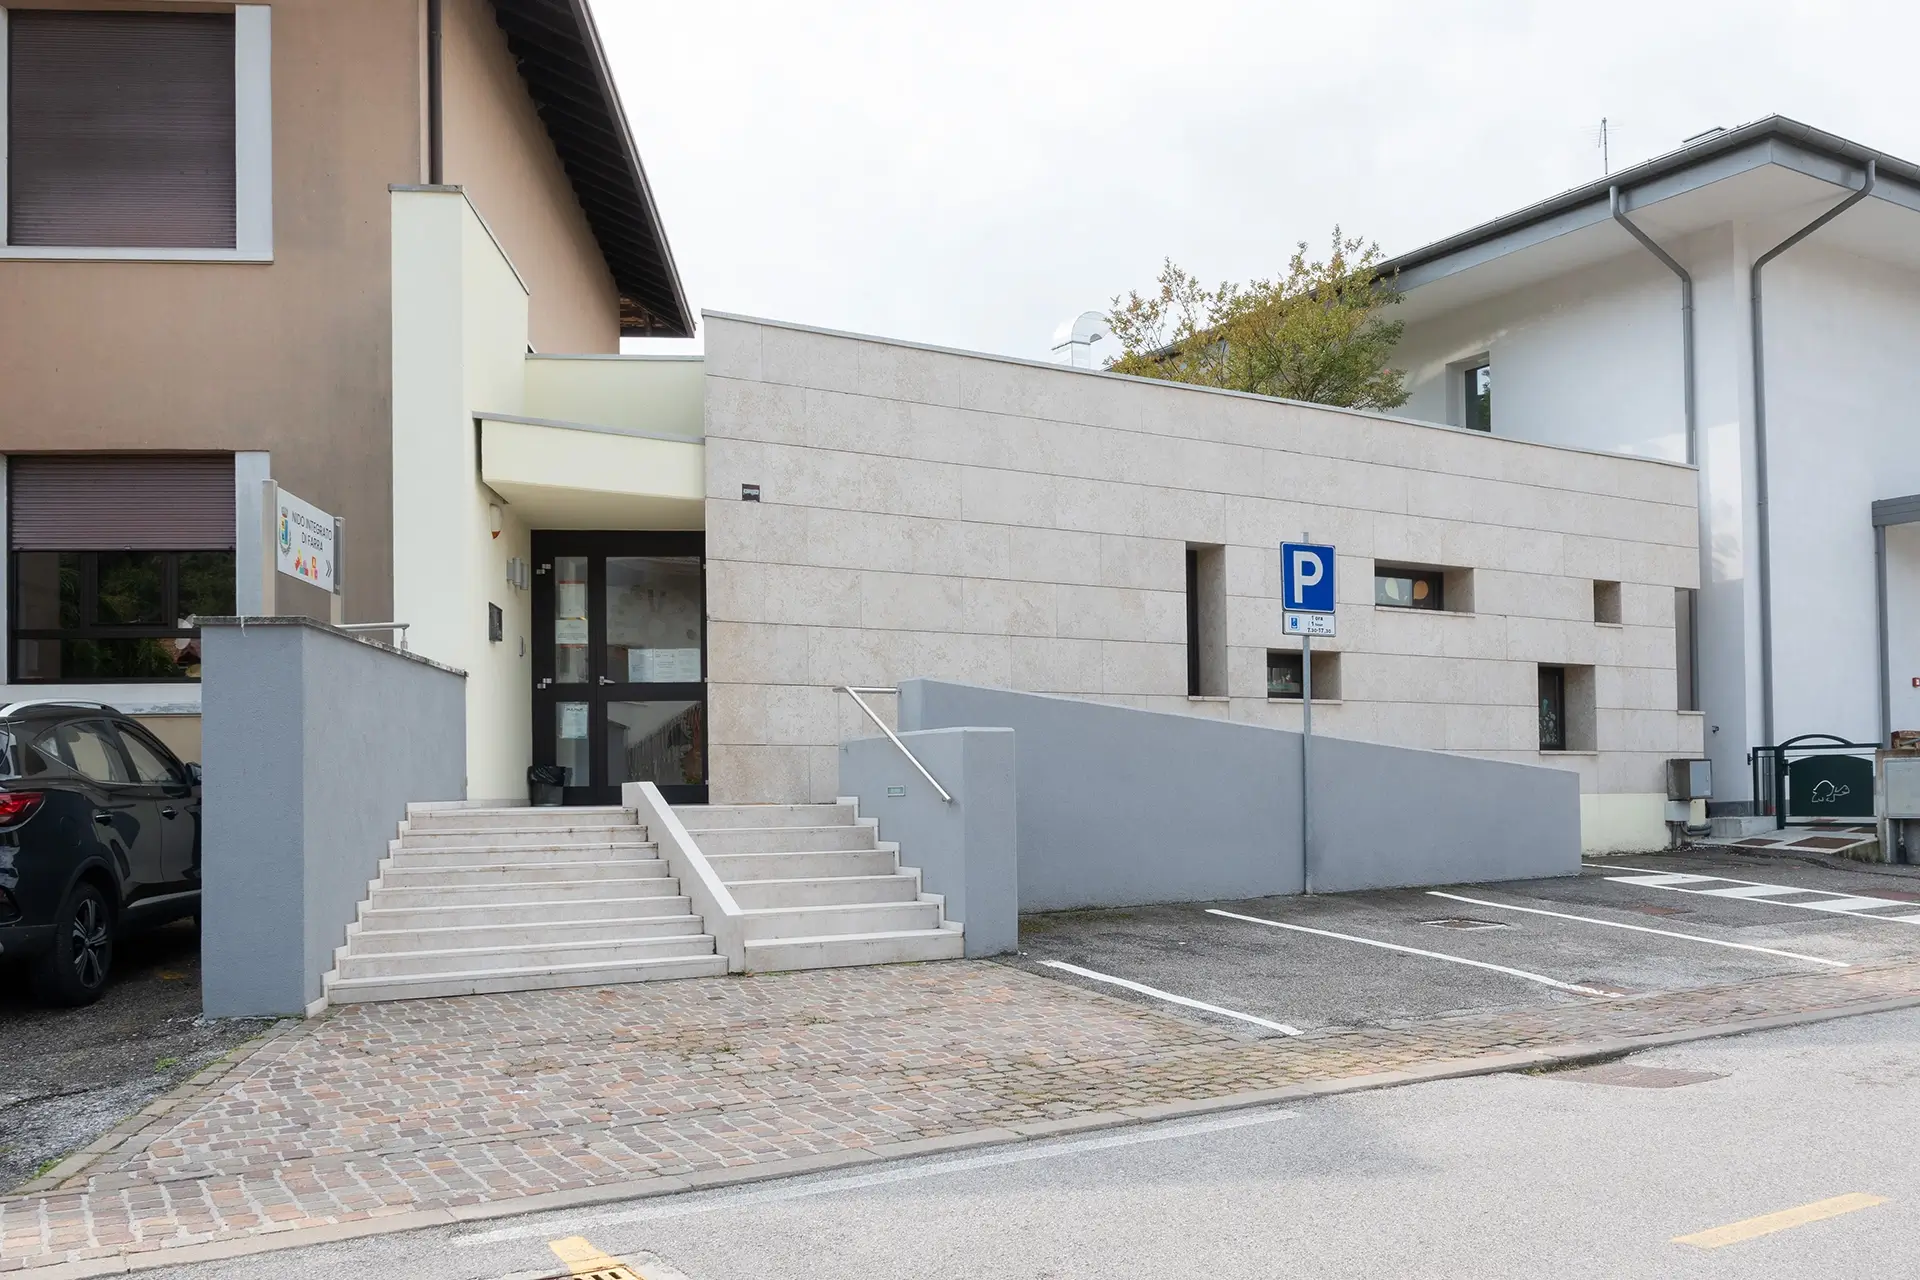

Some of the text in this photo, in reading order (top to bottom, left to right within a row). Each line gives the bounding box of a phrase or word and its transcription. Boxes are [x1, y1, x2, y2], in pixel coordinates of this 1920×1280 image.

[291, 510, 332, 541] NIDO INTEGRATO
[301, 531, 323, 552] DI FARRA
[1293, 550, 1324, 604] P
